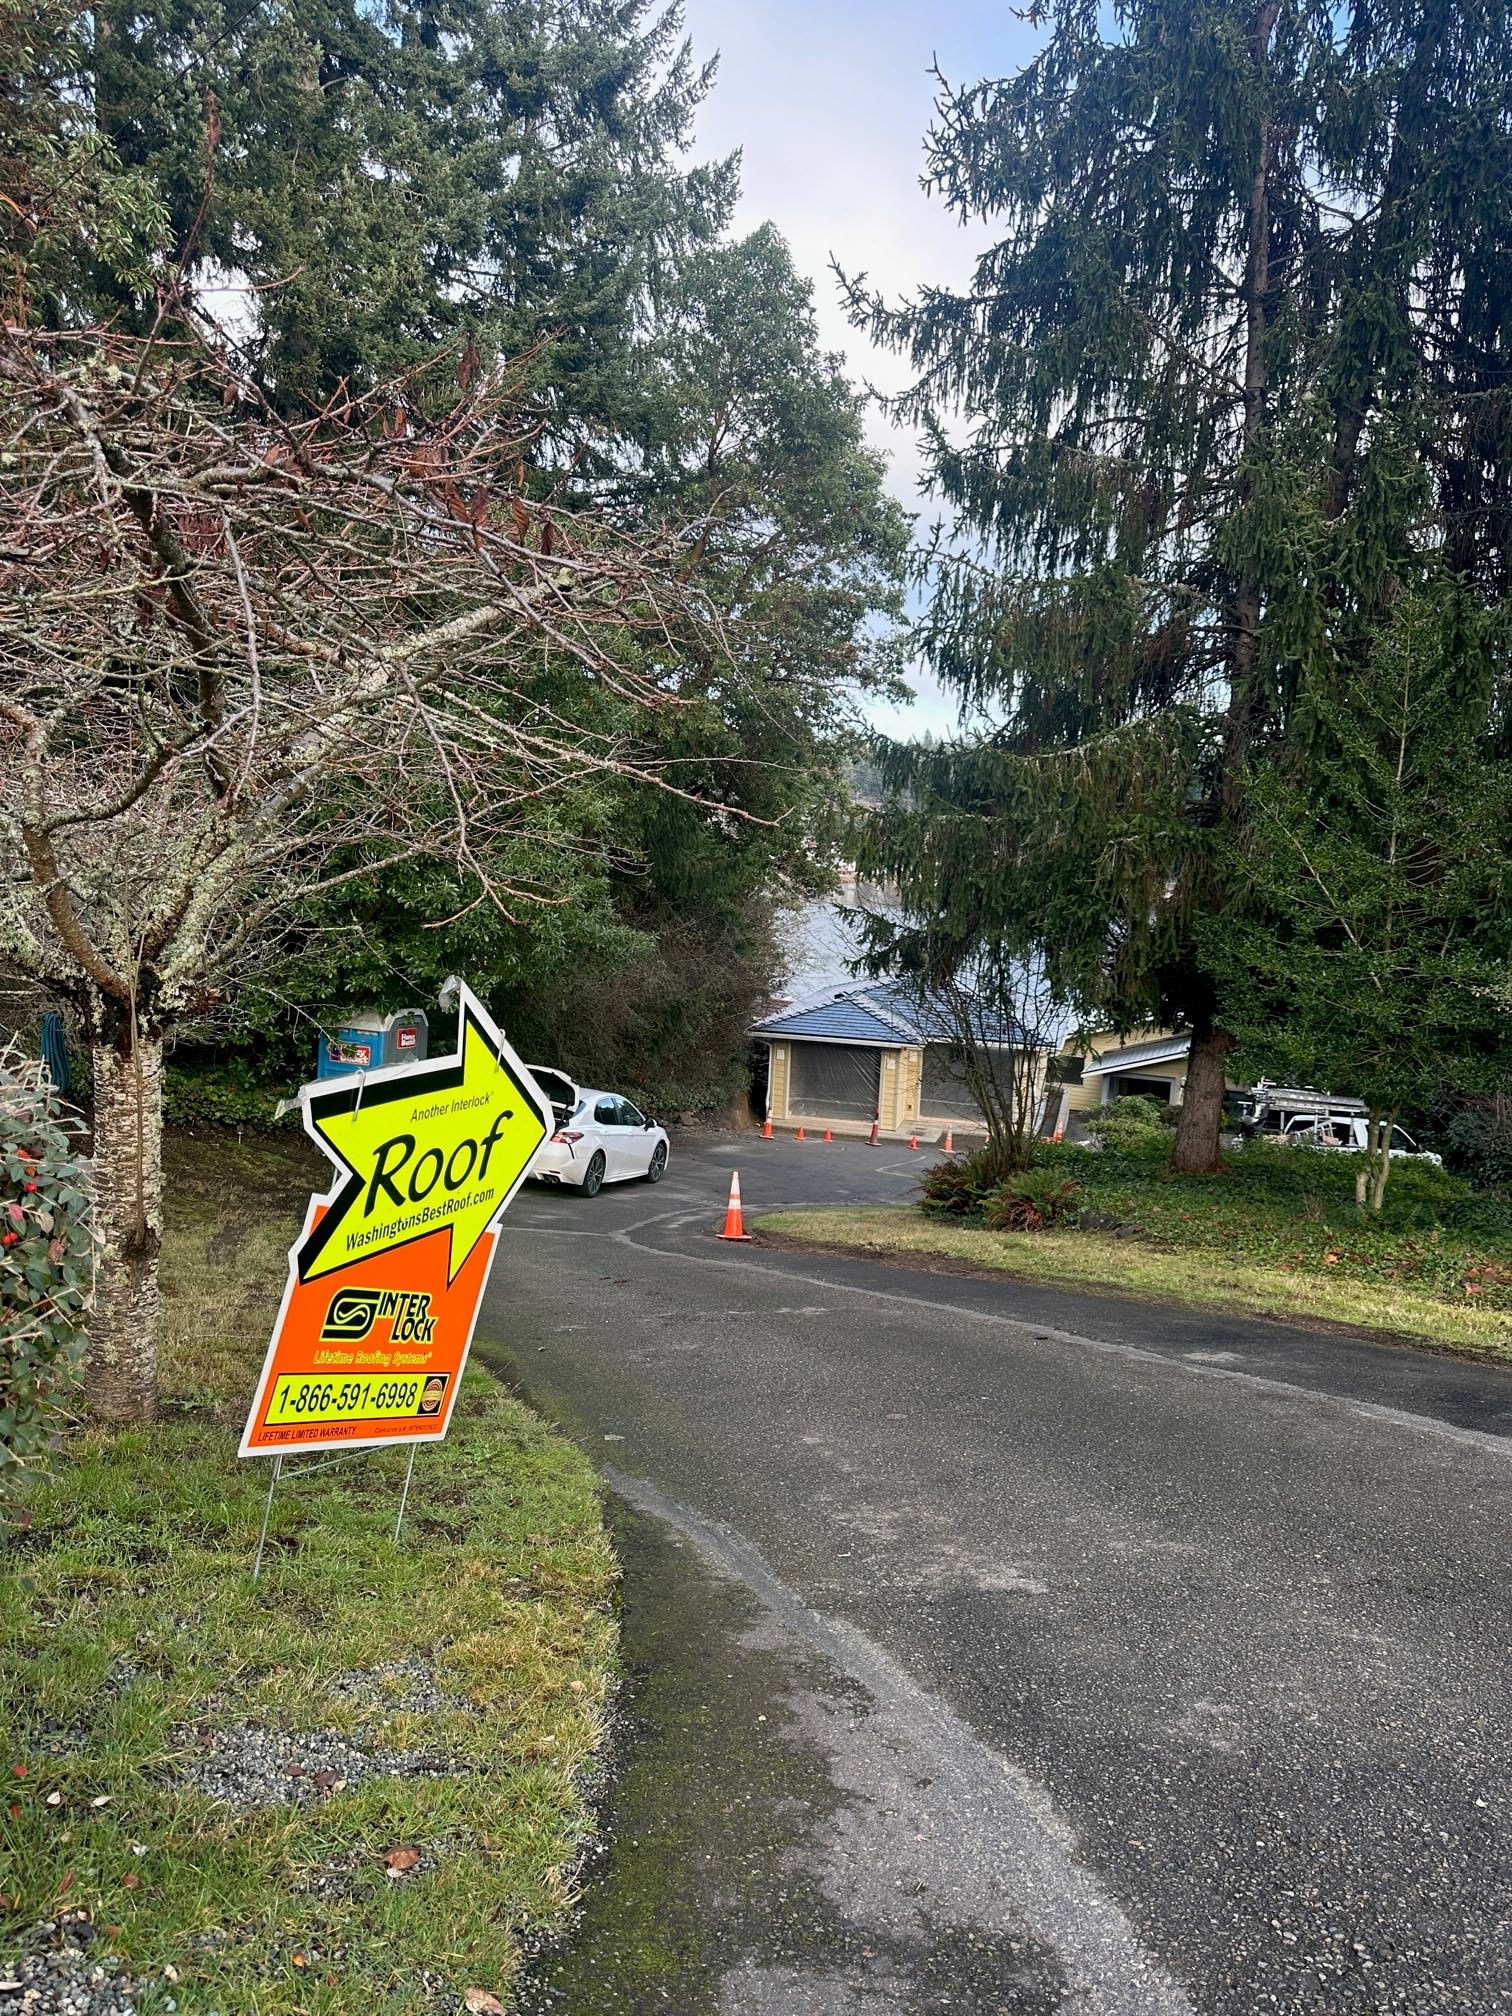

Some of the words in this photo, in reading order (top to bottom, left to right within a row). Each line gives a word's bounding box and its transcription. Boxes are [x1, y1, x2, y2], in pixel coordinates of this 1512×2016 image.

[411, 1103, 449, 1123] Another
[364, 1110, 514, 1218] Roof
[346, 1188, 495, 1251] WashingtonsBestRoof.com
[378, 1291, 431, 1319] INTER
[391, 1317, 436, 1341] LOCK
[313, 1350, 354, 1364] Lifetime
[355, 1351, 392, 1367] Roofing
[280, 1382, 418, 1414] 1-866-591-6998
[257, 1430, 291, 1442] LIFETIME
[291, 1428, 319, 1439] LIMITED
[319, 1426, 357, 1437] WARRANTY
